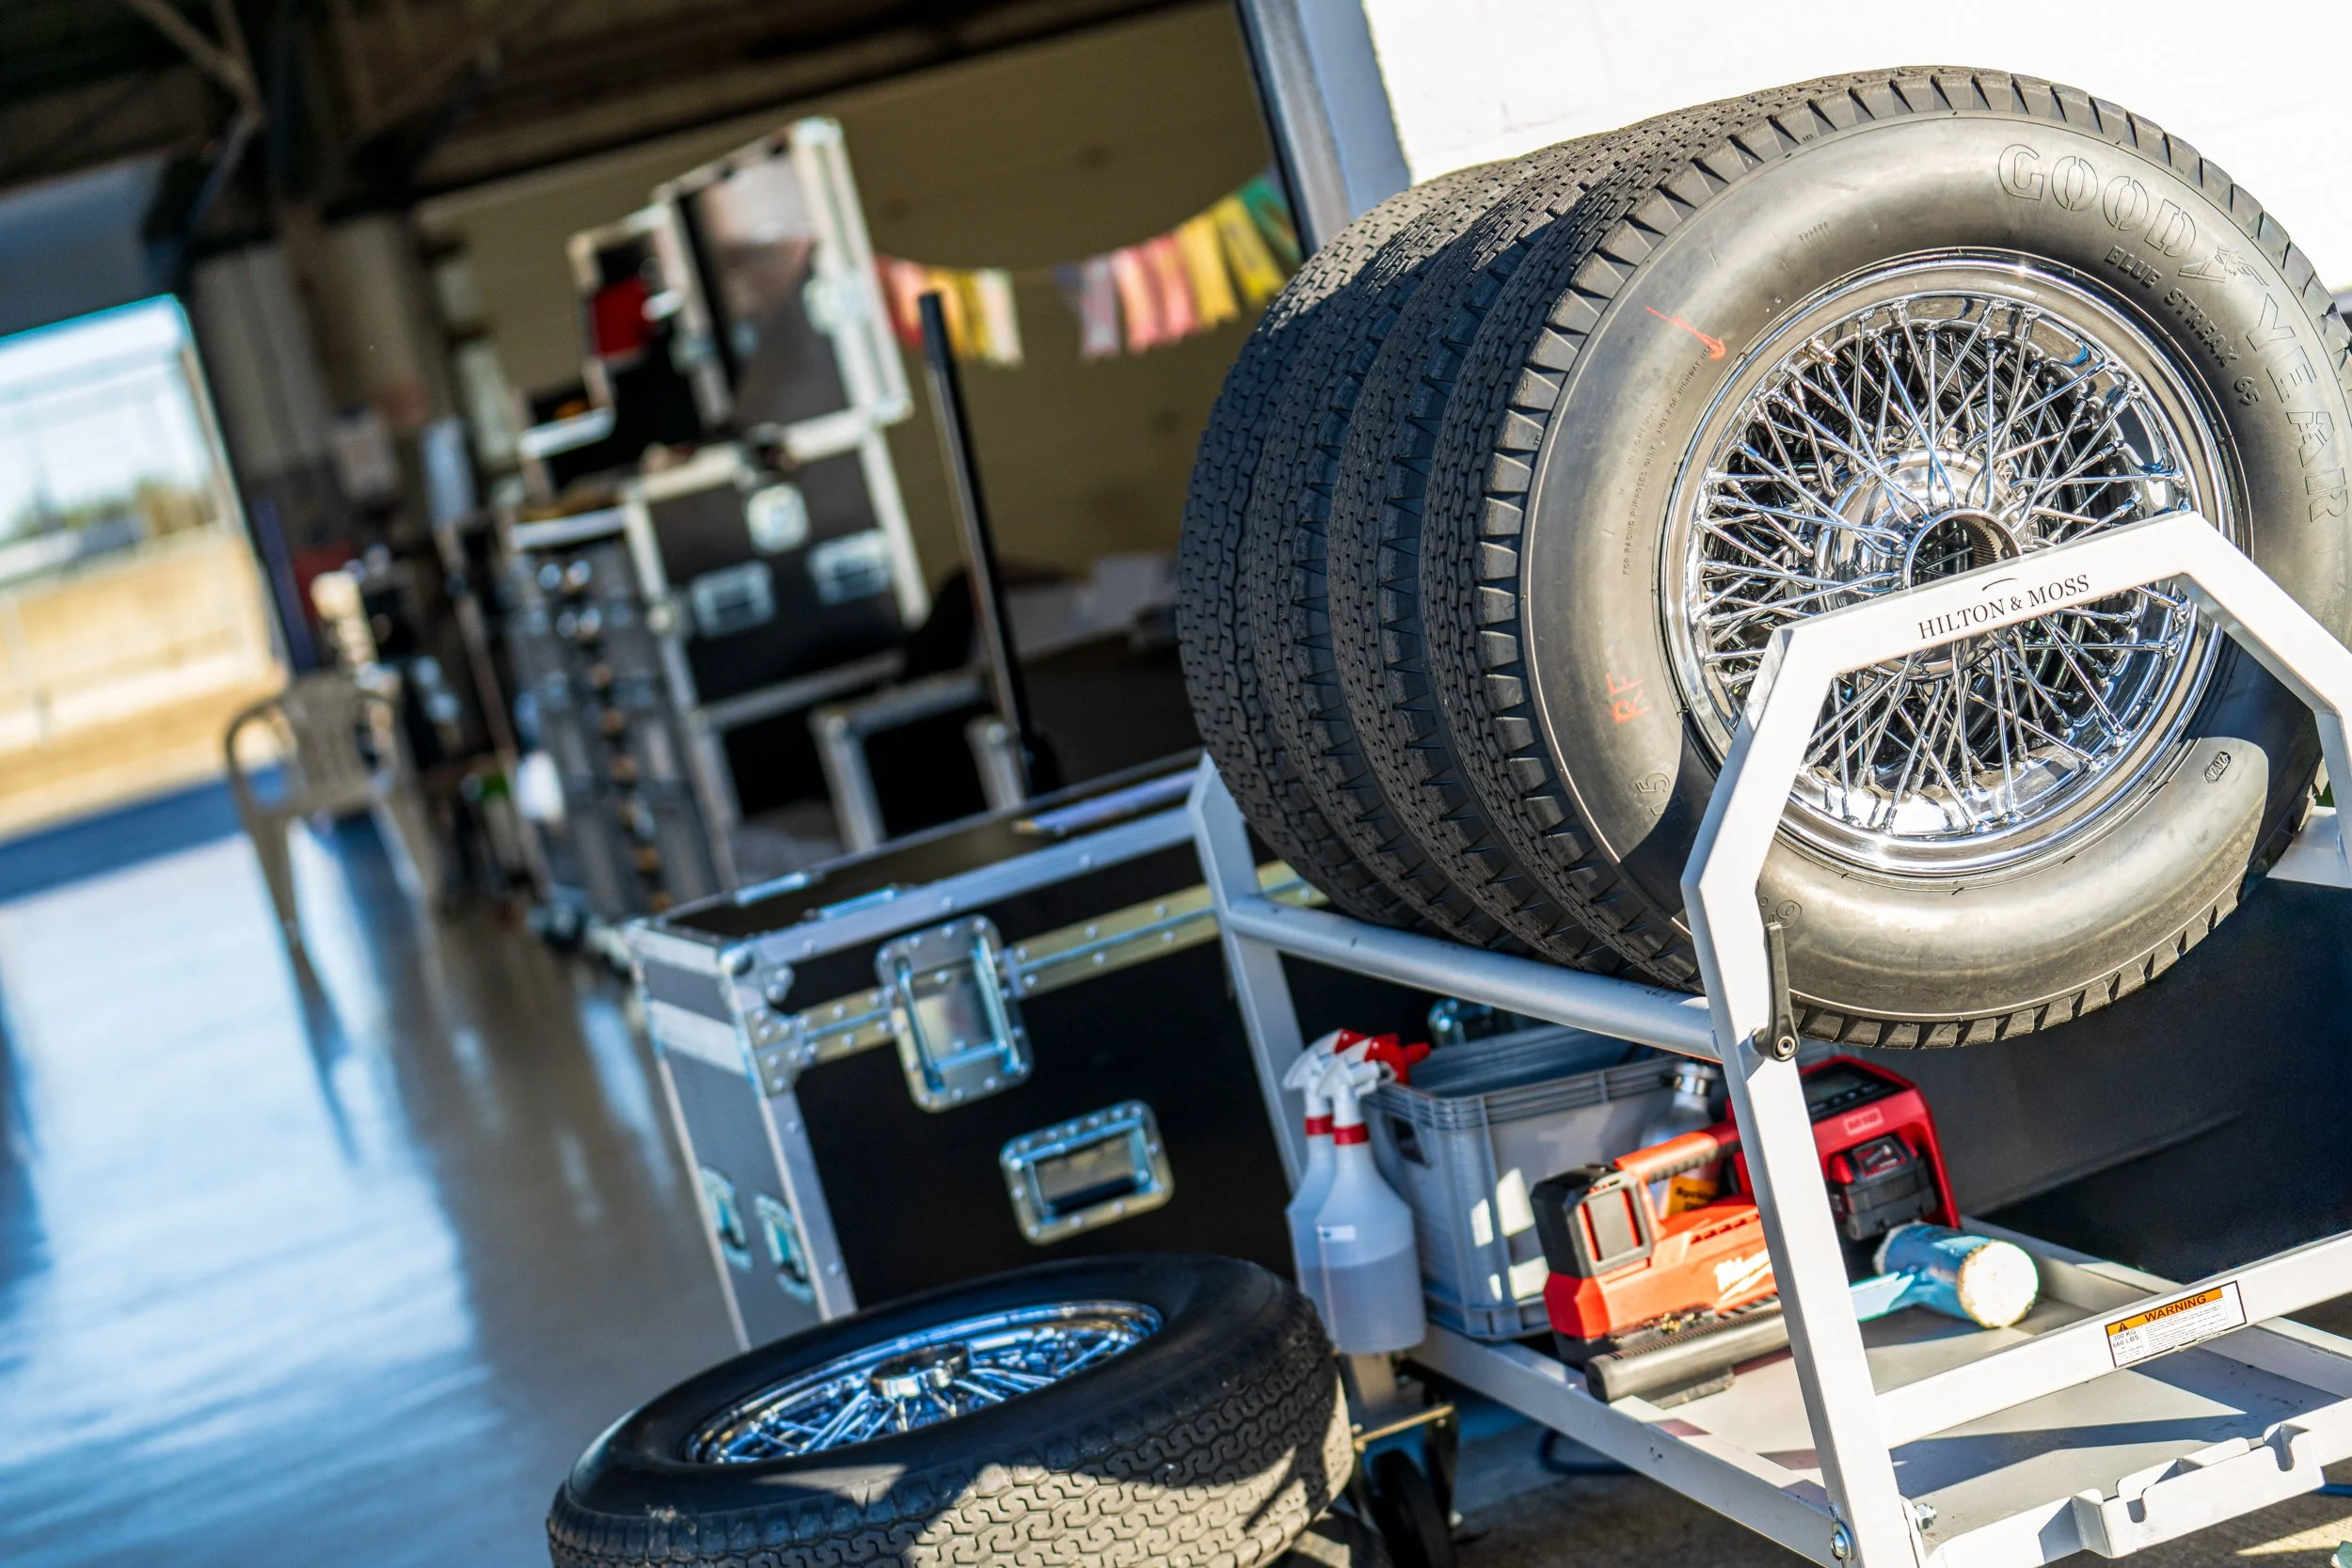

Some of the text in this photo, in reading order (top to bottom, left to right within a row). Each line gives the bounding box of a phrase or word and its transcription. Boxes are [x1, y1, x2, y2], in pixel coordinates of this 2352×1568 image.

[2105, 245, 2262, 406] BLUE STREAK 65
[1917, 574, 2090, 640] HILTON & MOSS
[2145, 1294, 2206, 1323] WARNING
[2113, 1333, 2125, 1341] 300
